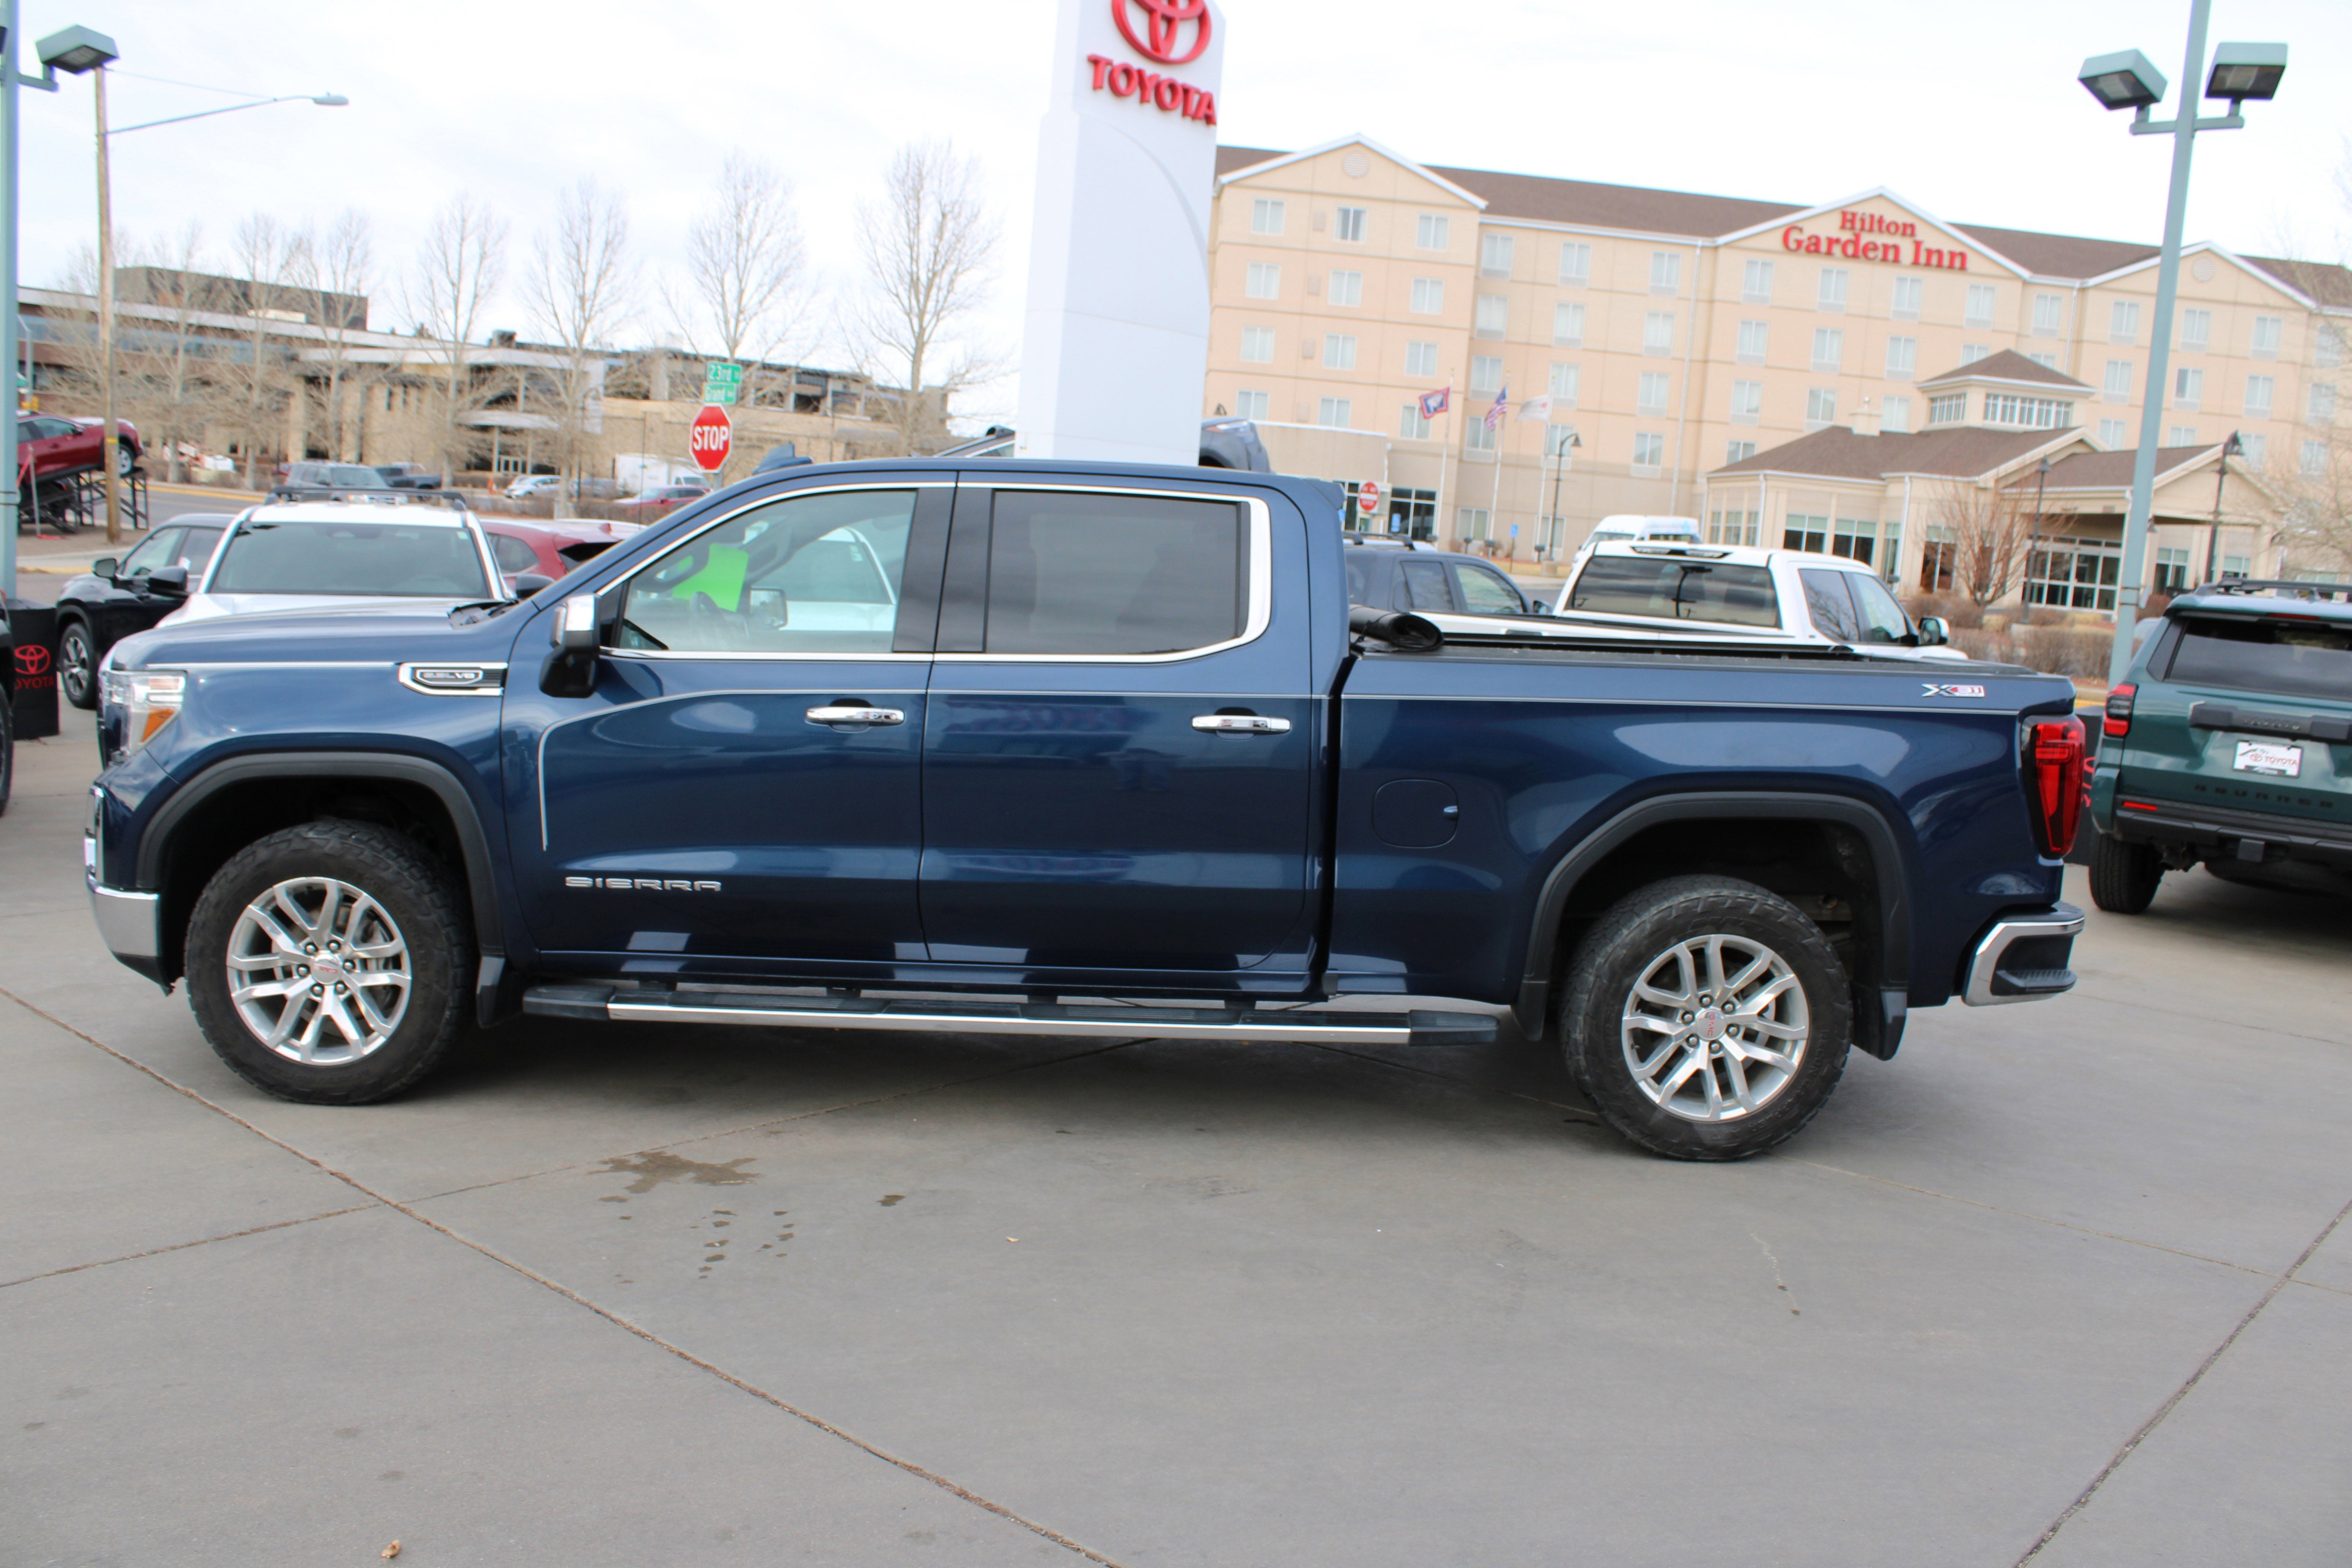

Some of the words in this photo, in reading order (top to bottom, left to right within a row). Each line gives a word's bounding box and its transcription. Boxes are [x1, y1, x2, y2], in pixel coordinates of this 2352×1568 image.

[1087, 53, 1217, 126] TOYOTA
[1840, 210, 1917, 237] Hilton
[1783, 225, 1901, 263] Garden
[1912, 239, 1968, 270] Inn
[708, 364, 732, 381] 23rd
[705, 386, 725, 402] Grand
[693, 425, 729, 450] STOP
[14, 676, 55, 690] OYOTA
[2264, 755, 2299, 766] TOYOTA
[565, 876, 722, 891] SIERRA
